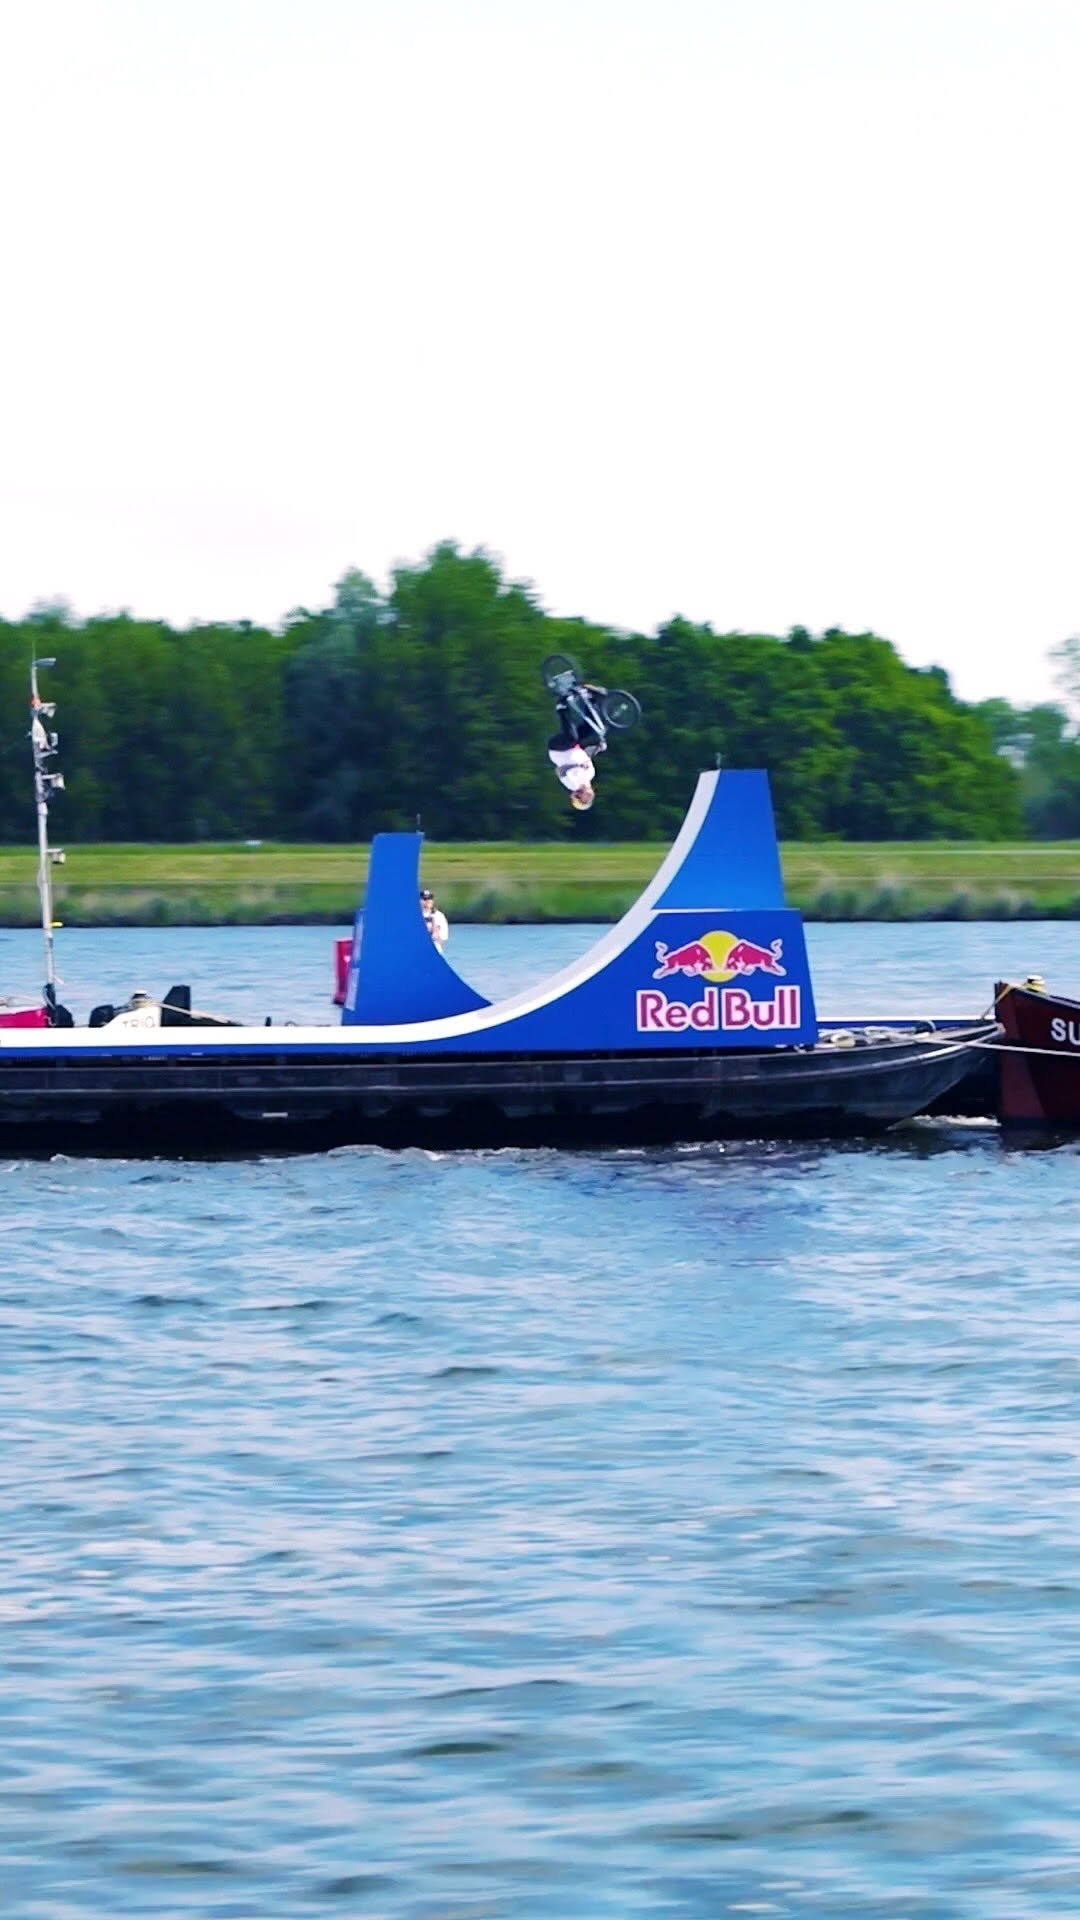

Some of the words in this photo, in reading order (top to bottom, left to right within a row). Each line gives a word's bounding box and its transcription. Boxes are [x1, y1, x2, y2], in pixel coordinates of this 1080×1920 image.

[639, 990, 715, 1028] Red
[724, 988, 798, 1027] Bull
[1050, 1017, 1080, 1046] SU
